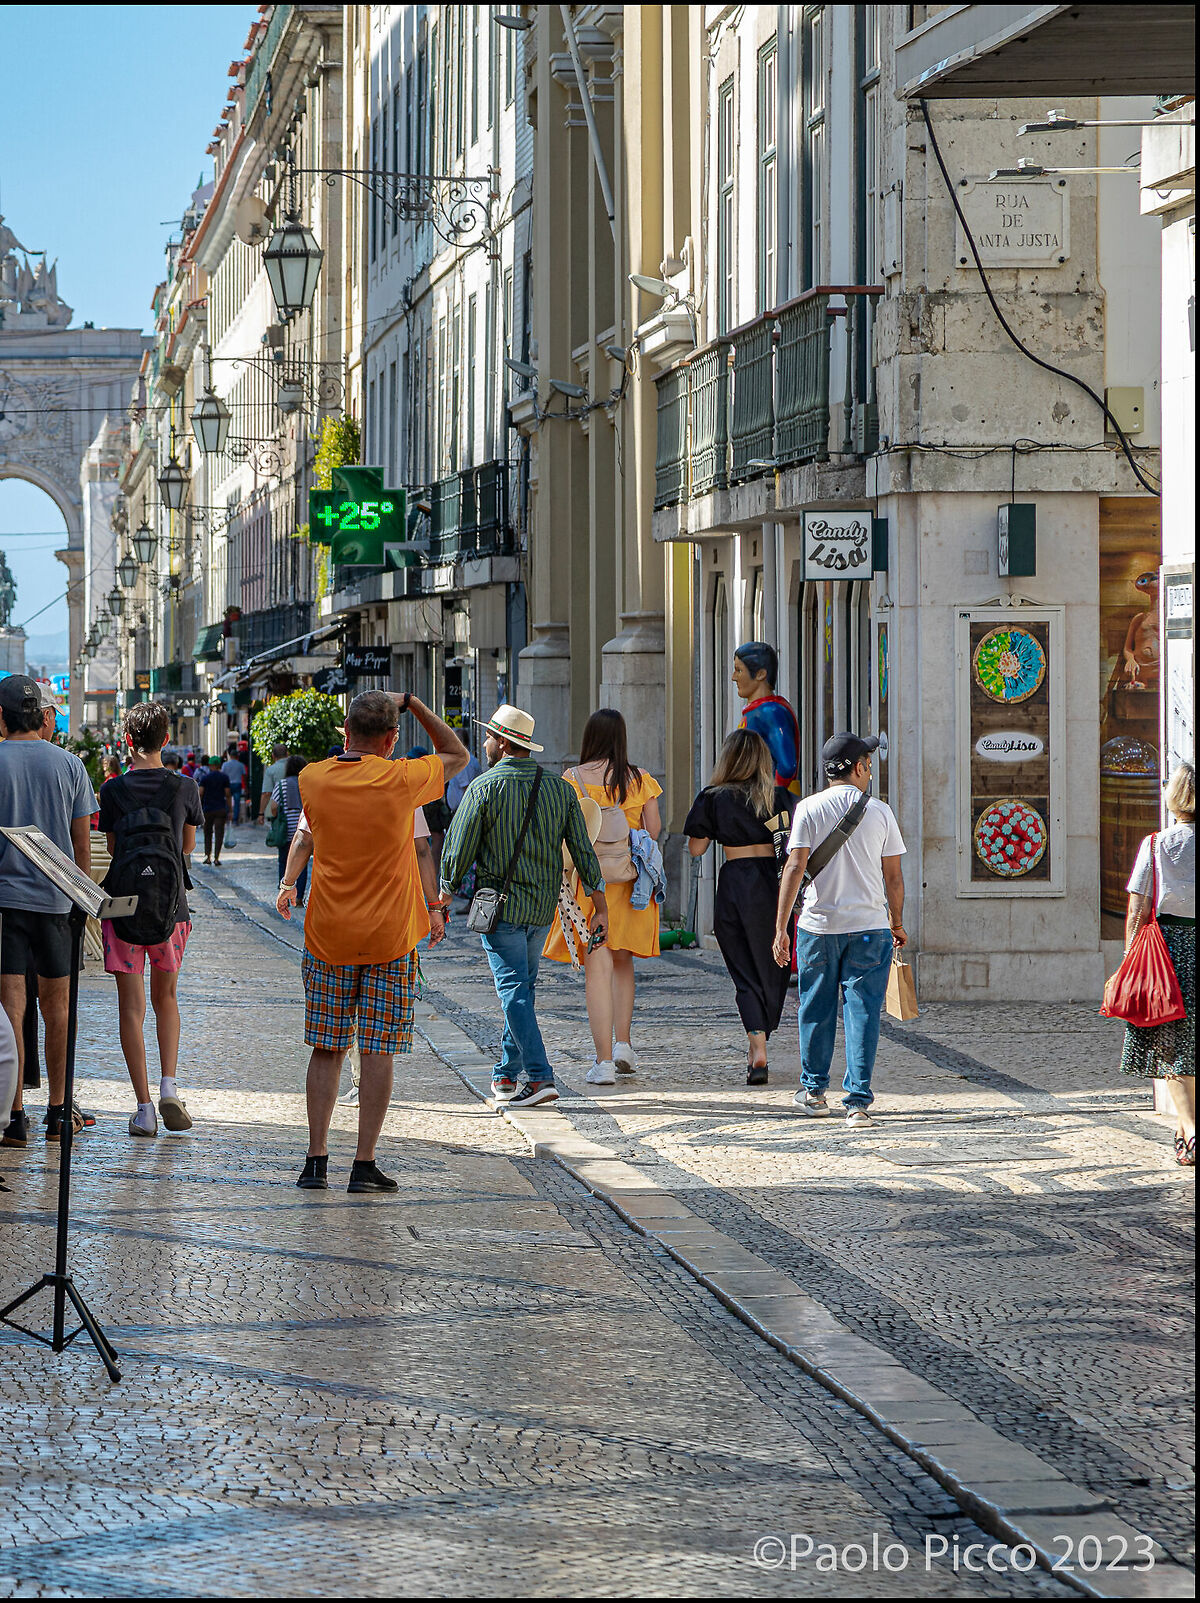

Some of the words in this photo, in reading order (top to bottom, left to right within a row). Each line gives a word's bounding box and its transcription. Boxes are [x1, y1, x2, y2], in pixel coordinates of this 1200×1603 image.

[995, 194, 1029, 208] RUA
[1002, 214, 1023, 228] DE
[972, 234, 1010, 247] ANTA
[1017, 233, 1059, 247] JUSTA
[808, 520, 868, 547] Candy
[808, 543, 867, 570] Lisa
